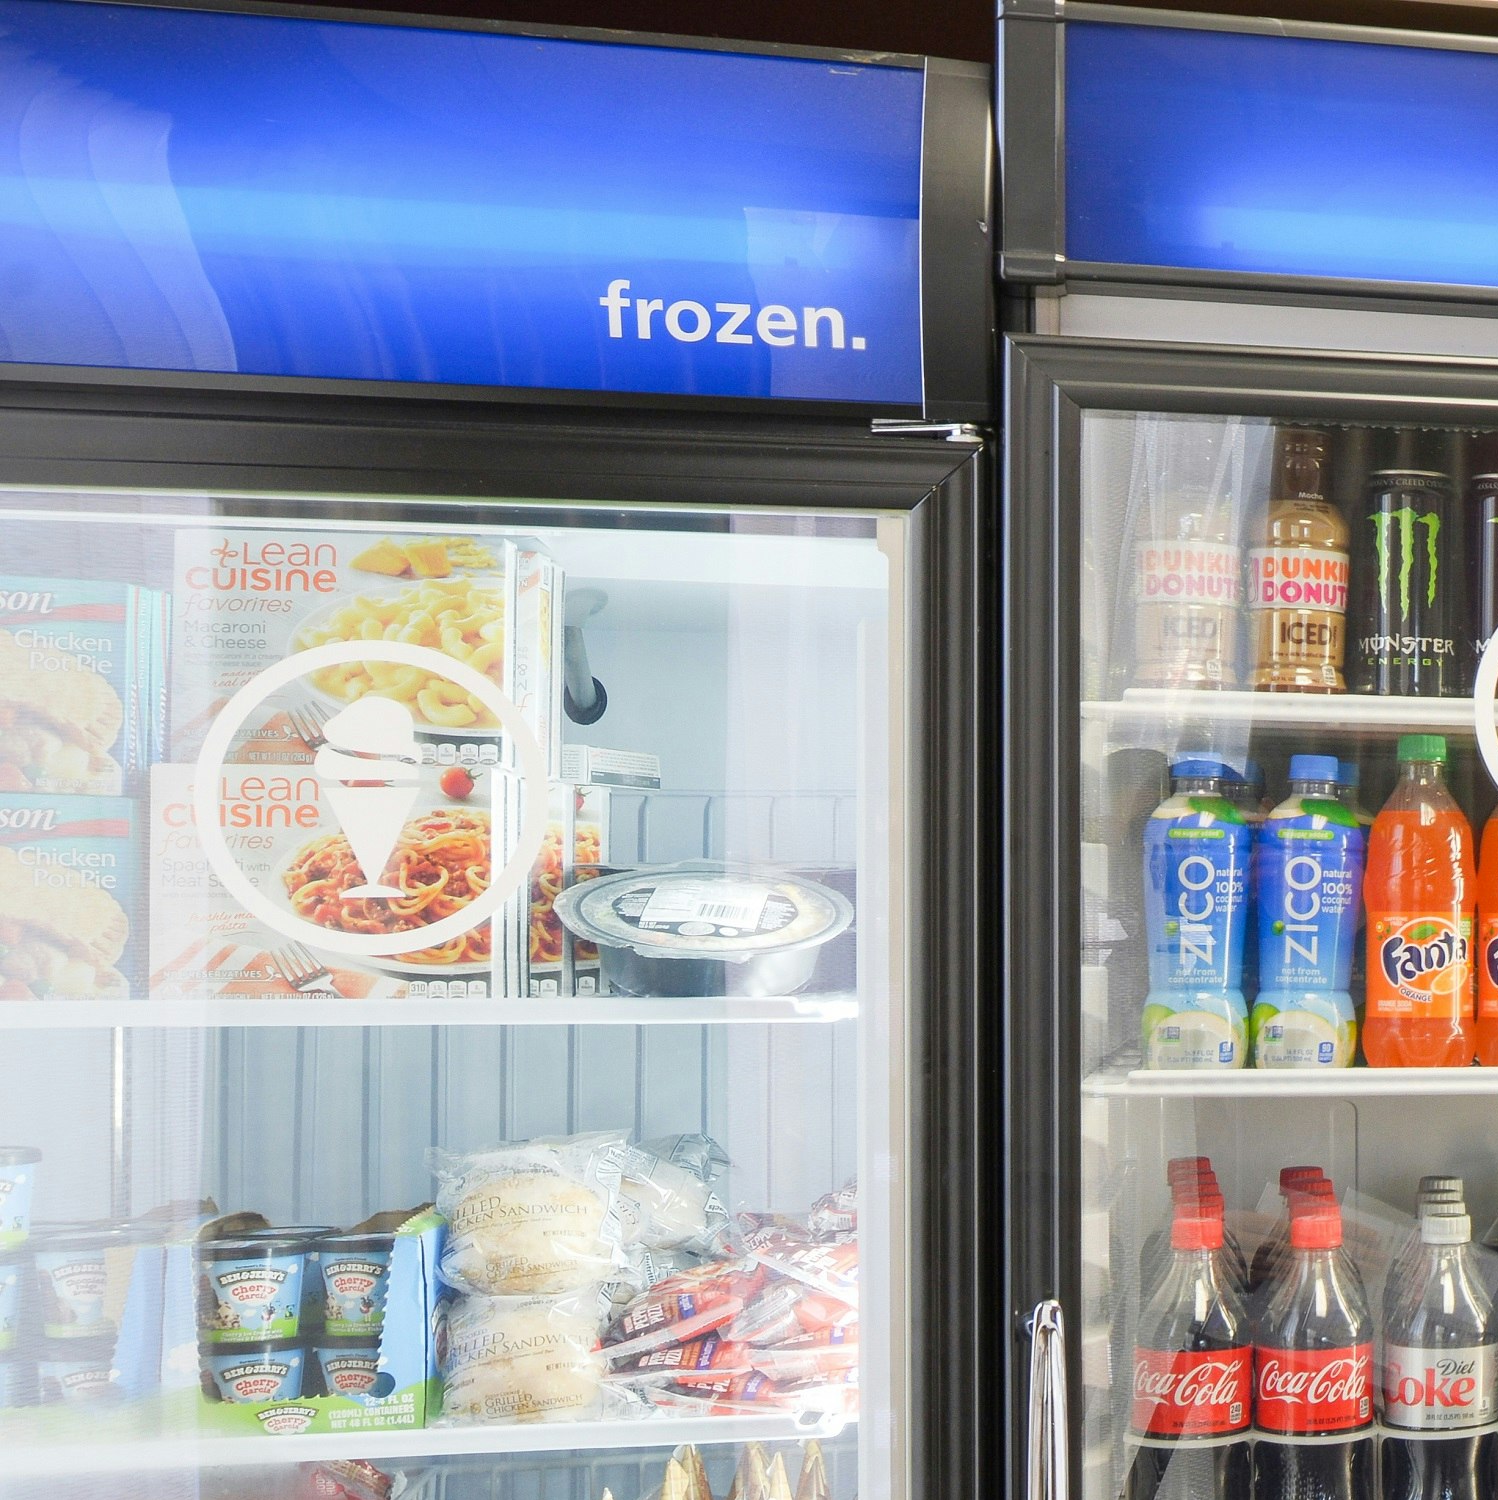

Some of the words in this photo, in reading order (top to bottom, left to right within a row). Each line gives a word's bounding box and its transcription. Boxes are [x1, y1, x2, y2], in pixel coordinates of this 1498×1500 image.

[600, 280, 867, 350] frozen.
[243, 541, 338, 567] Lean
[184, 620, 267, 635] Macaroni
[1280, 621, 1333, 646] ICED
[14, 629, 112, 653] Chicken
[204, 635, 267, 649] Cheese
[29, 650, 72, 672] Pot
[76, 654, 113, 674] Pie
[1367, 657, 1445, 667] ENERGY
[222, 776, 319, 801] Lean
[18, 847, 116, 869] Chicken
[33, 868, 74, 888] Pot
[79, 870, 117, 889] Pie
[1216, 868, 1243, 878] natural
[1323, 869, 1352, 879] natural
[1215, 882, 1244, 894] 100%
[1322, 882, 1353, 895] 100%
[1215, 895, 1243, 903] coconut
[1321, 896, 1352, 905] coconut
[1177, 855, 1216, 966] ZICO
[1215, 904, 1238, 913] water
[1284, 855, 1322, 966] ZICO
[1321, 905, 1346, 914] water
[1382, 931, 1469, 986] Fanta
[1168, 975, 1223, 984] concentrate
[1275, 975, 1328, 984] concentrate
[1399, 987, 1432, 1002] ORANGE
[501, 1203, 588, 1218] SANDWICH
[334, 1276, 375, 1288] Cherry
[232, 1283, 277, 1297] Cherry
[1436, 1358, 1475, 1376] Diet
[235, 1378, 279, 1391] Cherry
[1132, 1358, 1243, 1407] Coca-Cola
[1259, 1355, 1369, 1405] Coca-Cola
[485, 1394, 533, 1407] GRILLED
[364, 1405, 415, 1417] CONTAINERS
